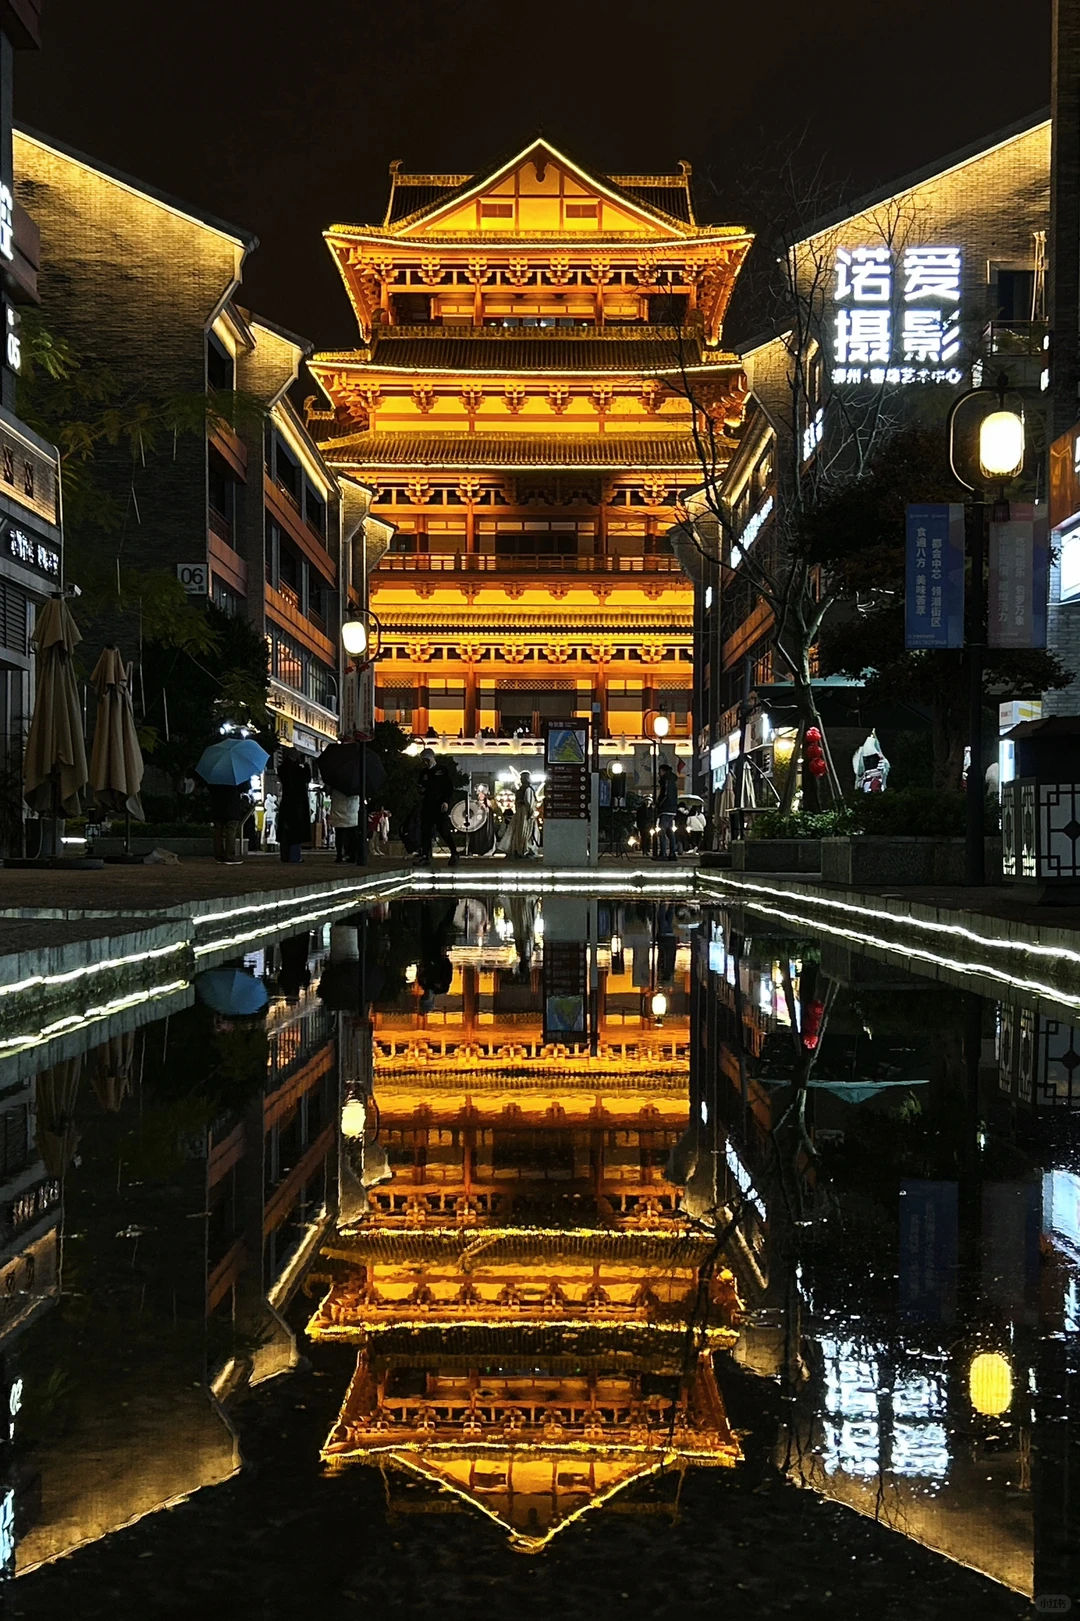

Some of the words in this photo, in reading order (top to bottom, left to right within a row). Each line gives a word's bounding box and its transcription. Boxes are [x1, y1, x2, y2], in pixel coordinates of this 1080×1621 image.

[834, 247, 961, 302] 诺爱
[834, 308, 961, 362] 摄影
[181, 567, 203, 584] 06
